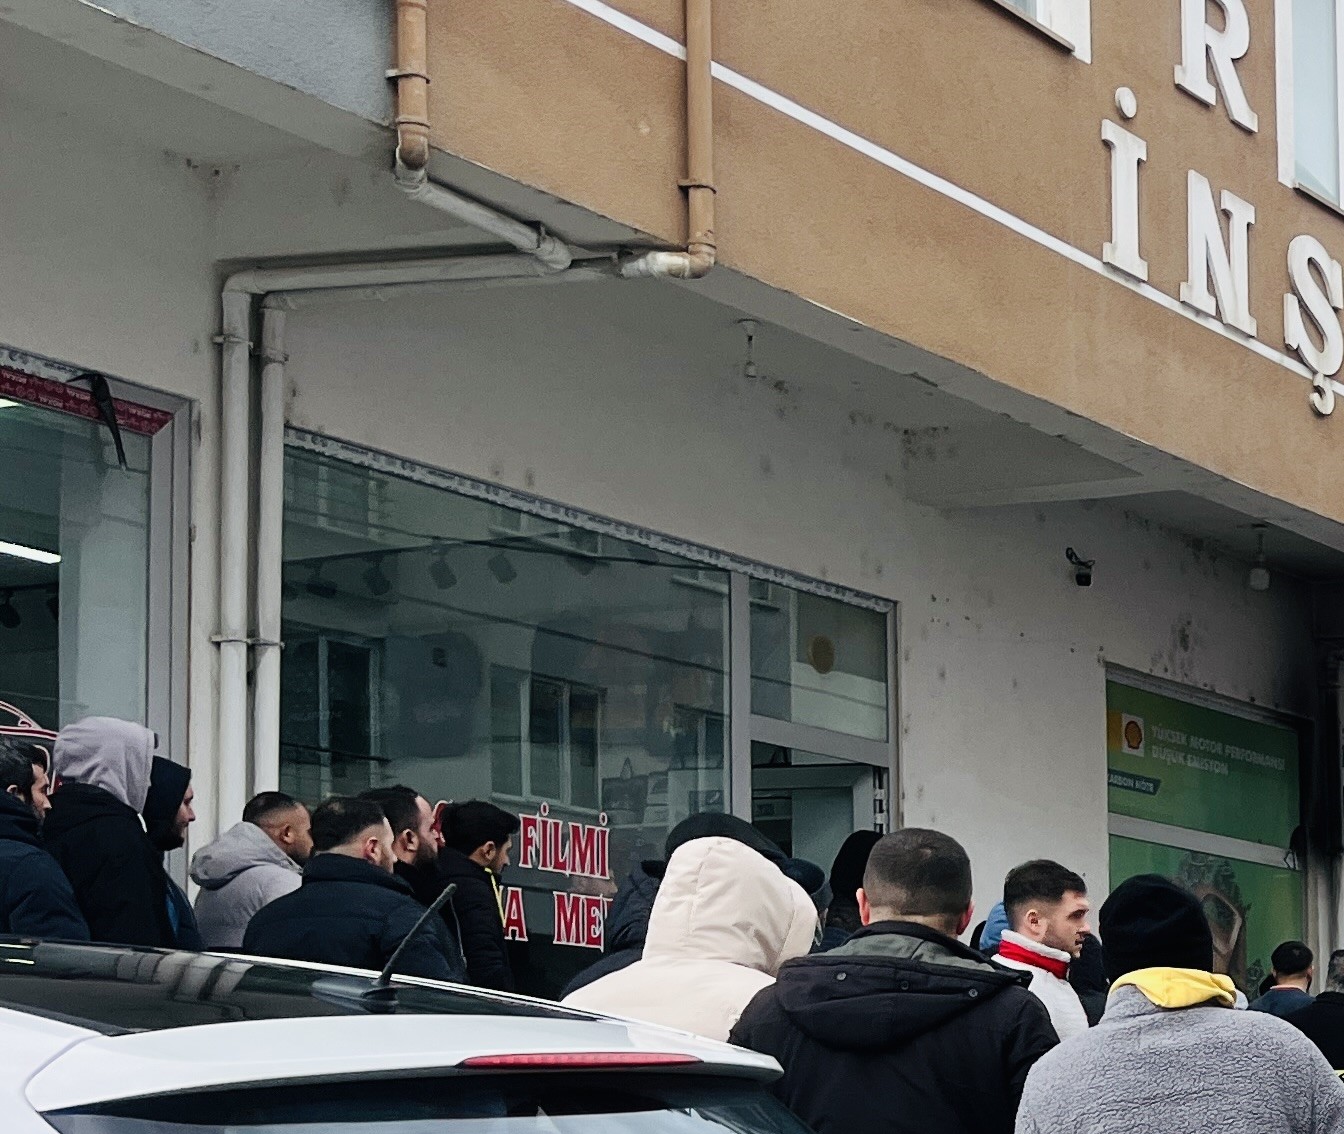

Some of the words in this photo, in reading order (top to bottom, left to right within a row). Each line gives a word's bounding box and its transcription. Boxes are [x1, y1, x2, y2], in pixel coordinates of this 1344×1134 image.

[1174, 0, 1259, 133] R
[1101, 86, 1344, 416] İNŞ
[519, 801, 610, 880] FİLMİ
